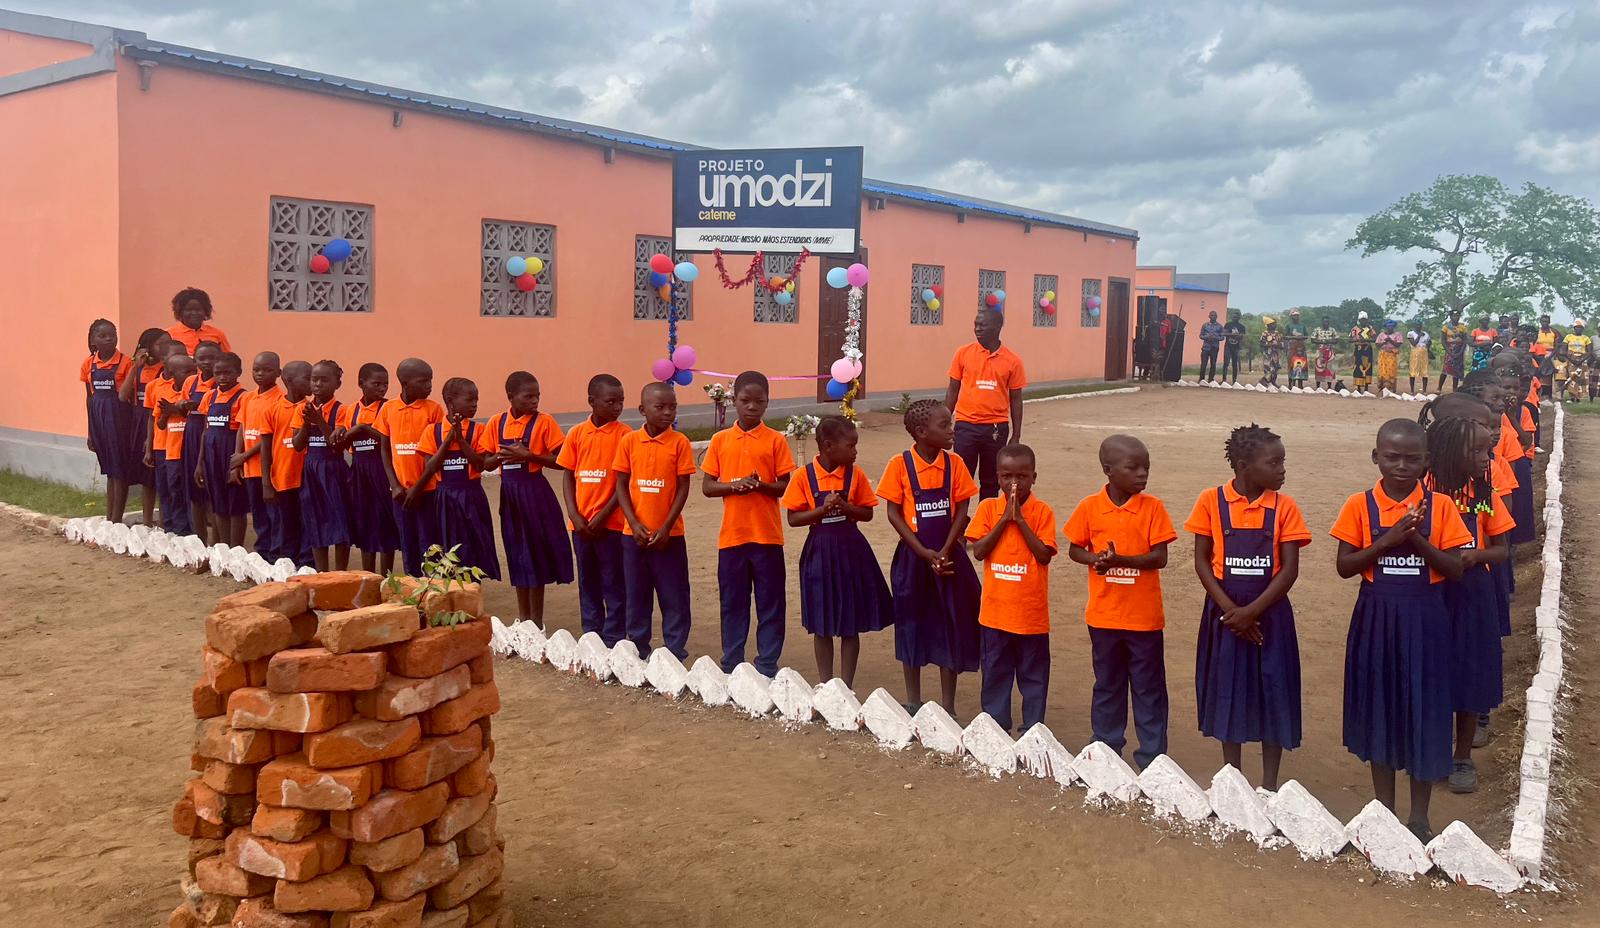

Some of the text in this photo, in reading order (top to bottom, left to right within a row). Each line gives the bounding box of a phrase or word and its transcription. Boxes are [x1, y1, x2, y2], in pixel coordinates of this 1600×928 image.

[699, 159, 764, 172] PROJETO
[699, 158, 832, 208] umodzi
[698, 209, 737, 221] cateme
[780, 236, 812, 244] ESTENDIDAS
[579, 468, 607, 478] umodzi
[637, 478, 665, 488] umodzi
[915, 498, 950, 512] umodzi
[1225, 555, 1269, 568] umodzi
[990, 562, 1028, 575] umodzi
[1105, 567, 1141, 577] modzi
